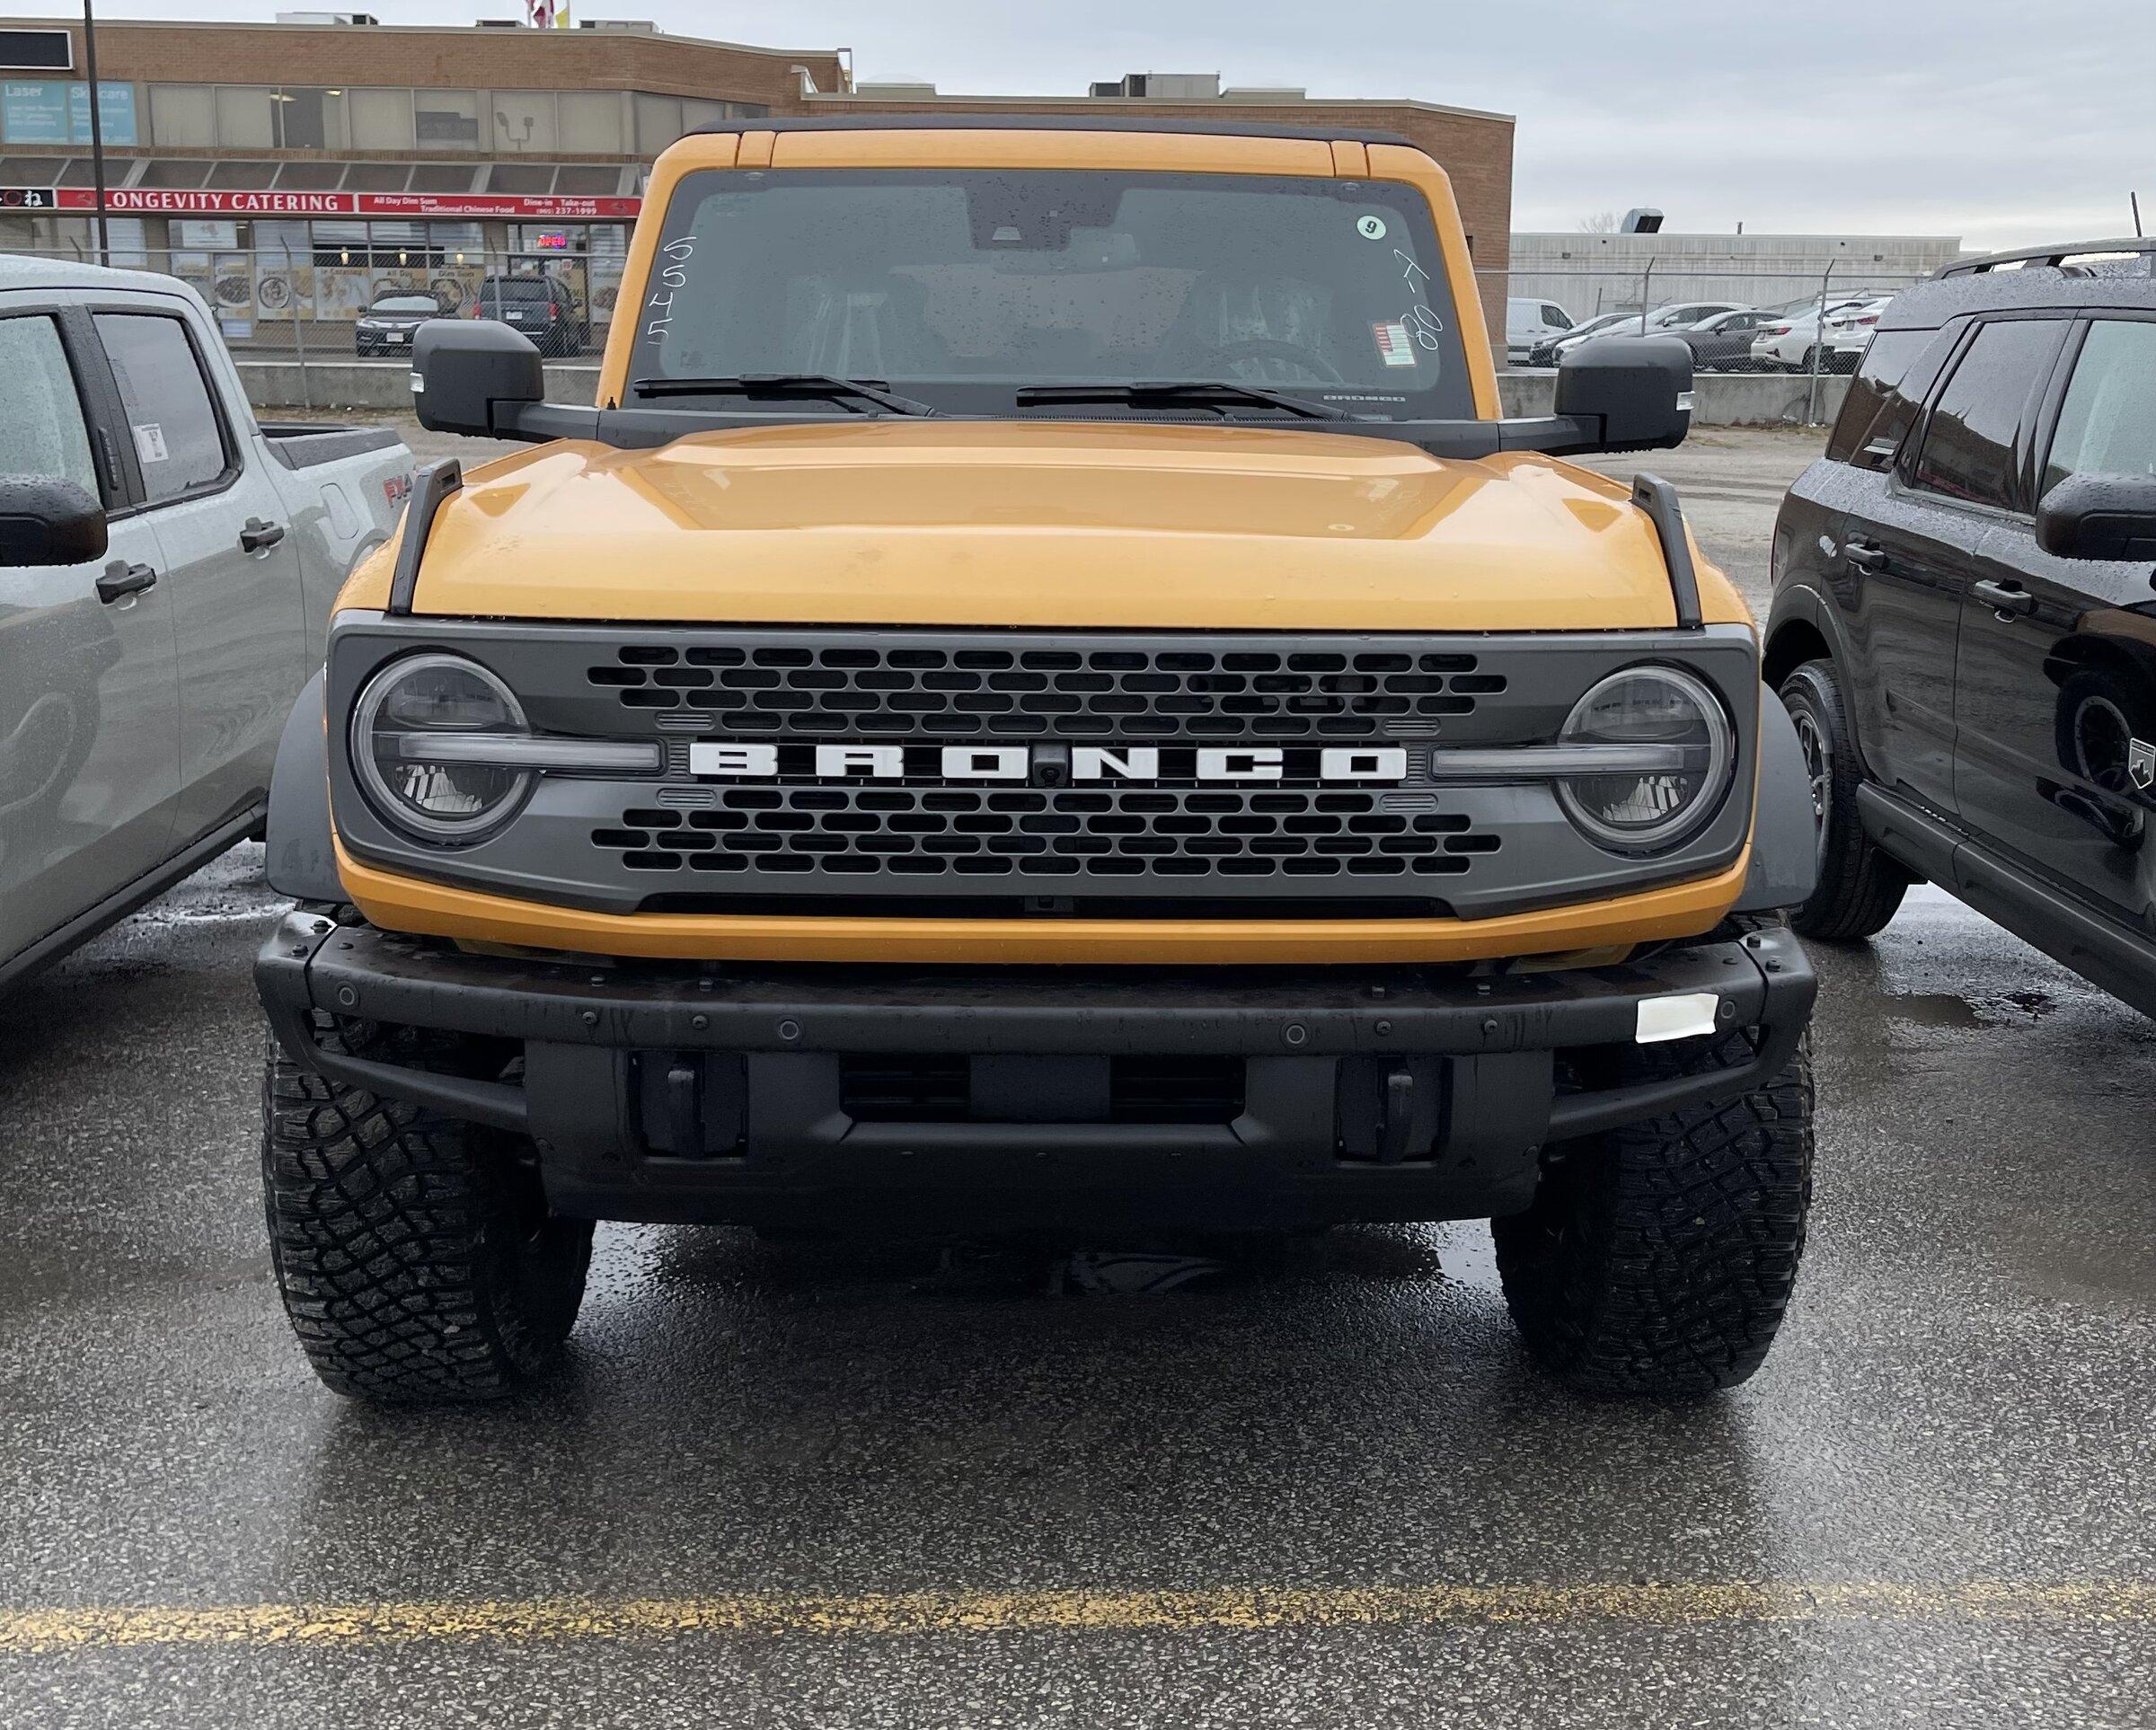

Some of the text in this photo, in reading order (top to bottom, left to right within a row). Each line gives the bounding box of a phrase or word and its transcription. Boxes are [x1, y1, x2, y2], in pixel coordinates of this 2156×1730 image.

[5, 84, 42, 97] Laser
[231, 194, 339, 211] CATERING
[386, 197, 401, 207] Day
[402, 197, 419, 205] Dim
[420, 197, 437, 205] Sum
[420, 205, 515, 214] Traditional Chinese Food
[1322, 394, 1406, 402] BRONCO
[689, 742, 1408, 781] BRONCO
